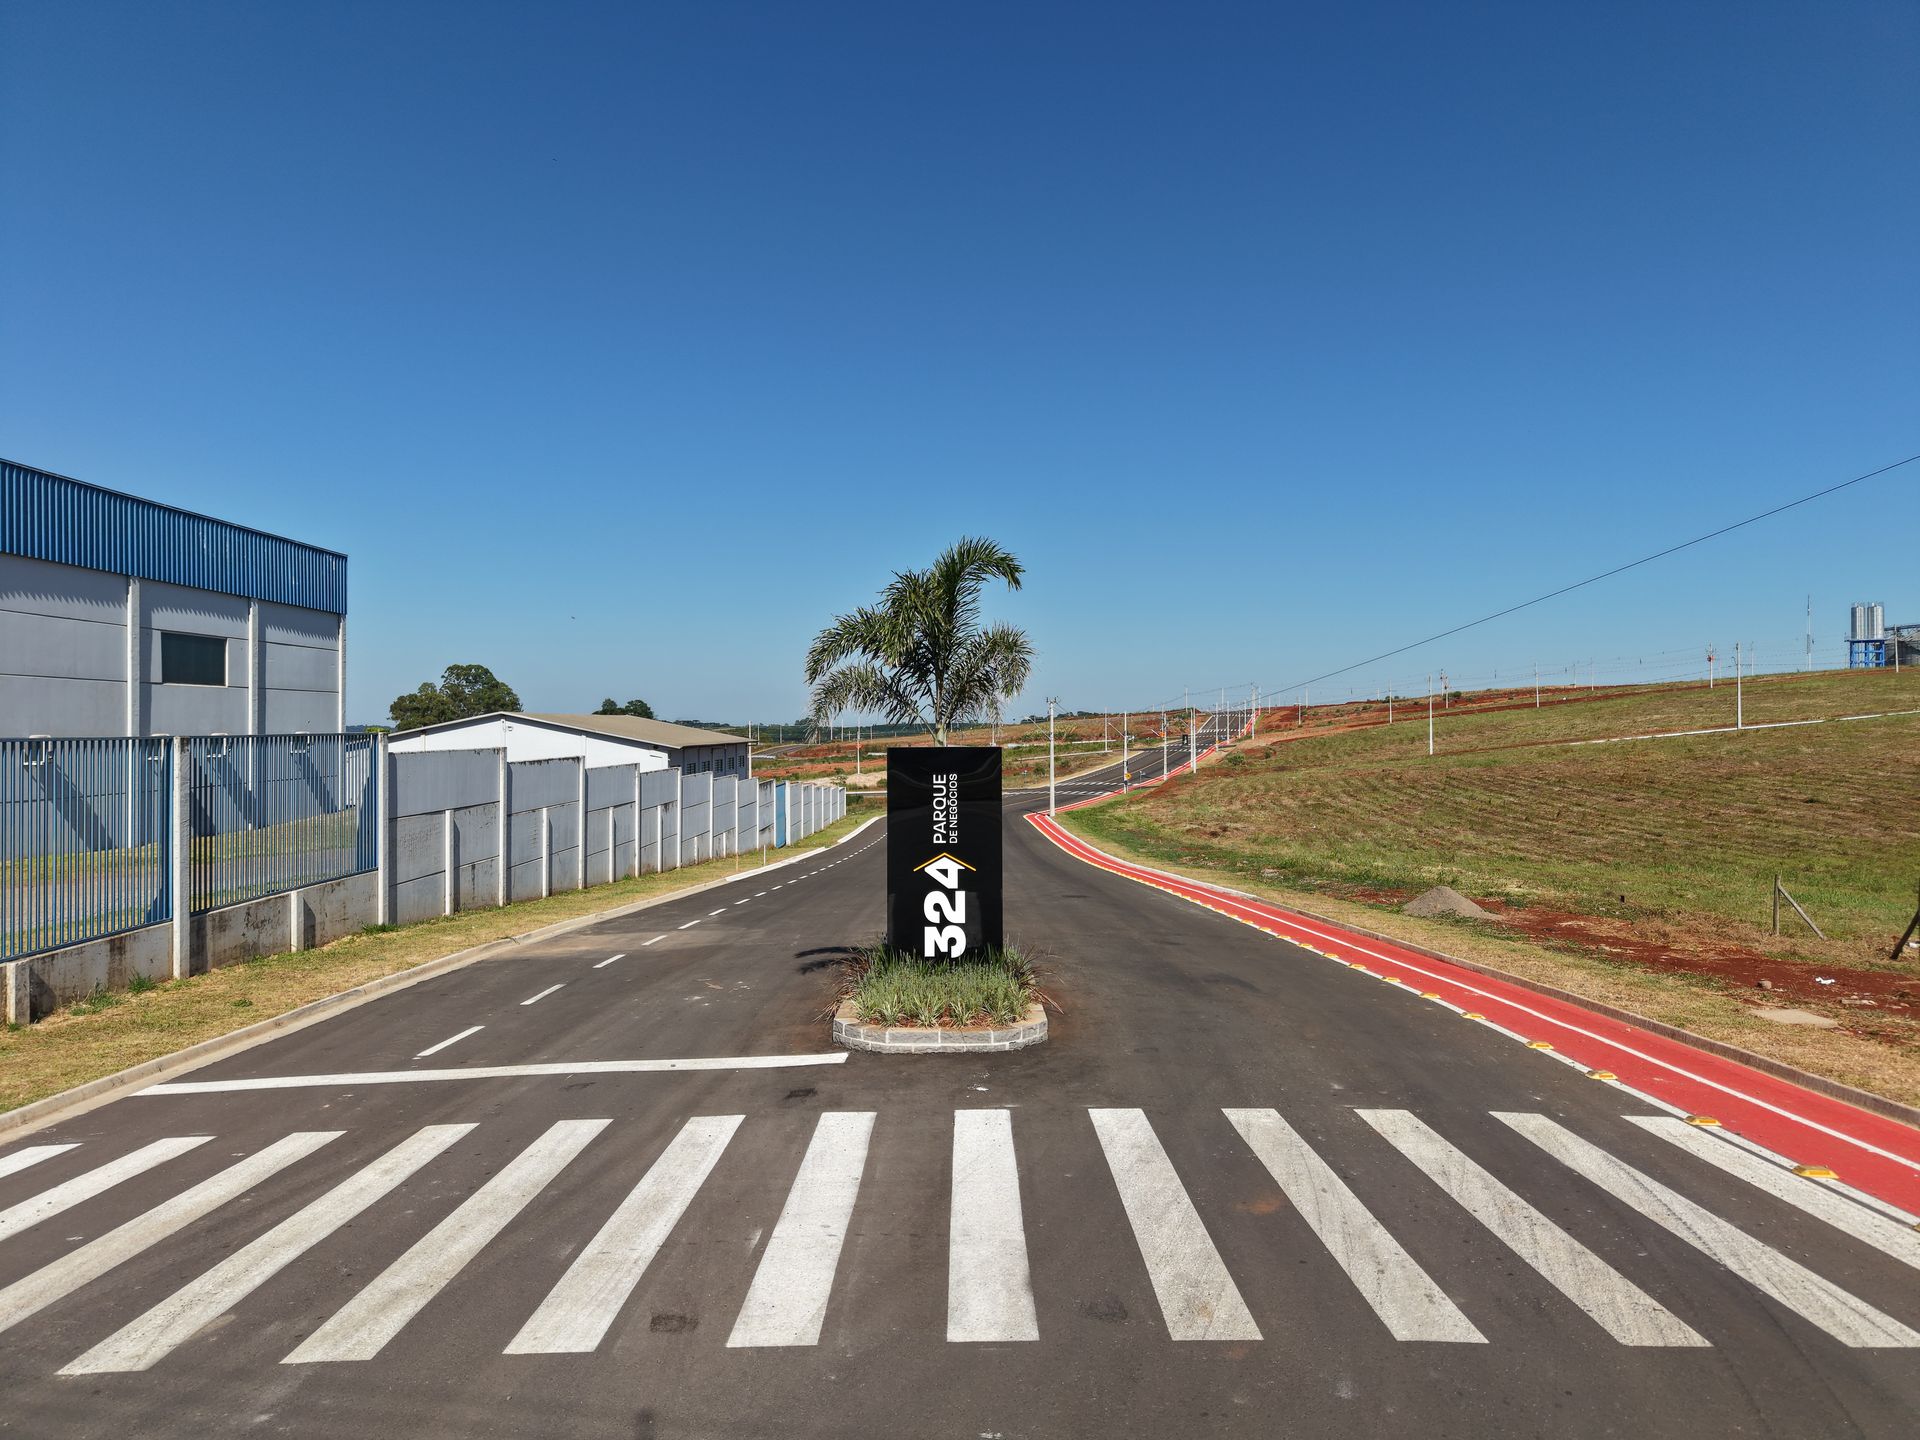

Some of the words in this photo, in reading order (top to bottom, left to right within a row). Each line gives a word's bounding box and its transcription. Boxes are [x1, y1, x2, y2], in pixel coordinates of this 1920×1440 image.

[933, 774, 947, 844] PARQUE
[947, 773, 958, 828] NEGÓCIOS
[949, 830, 958, 844] DE
[924, 856, 967, 959] 324
